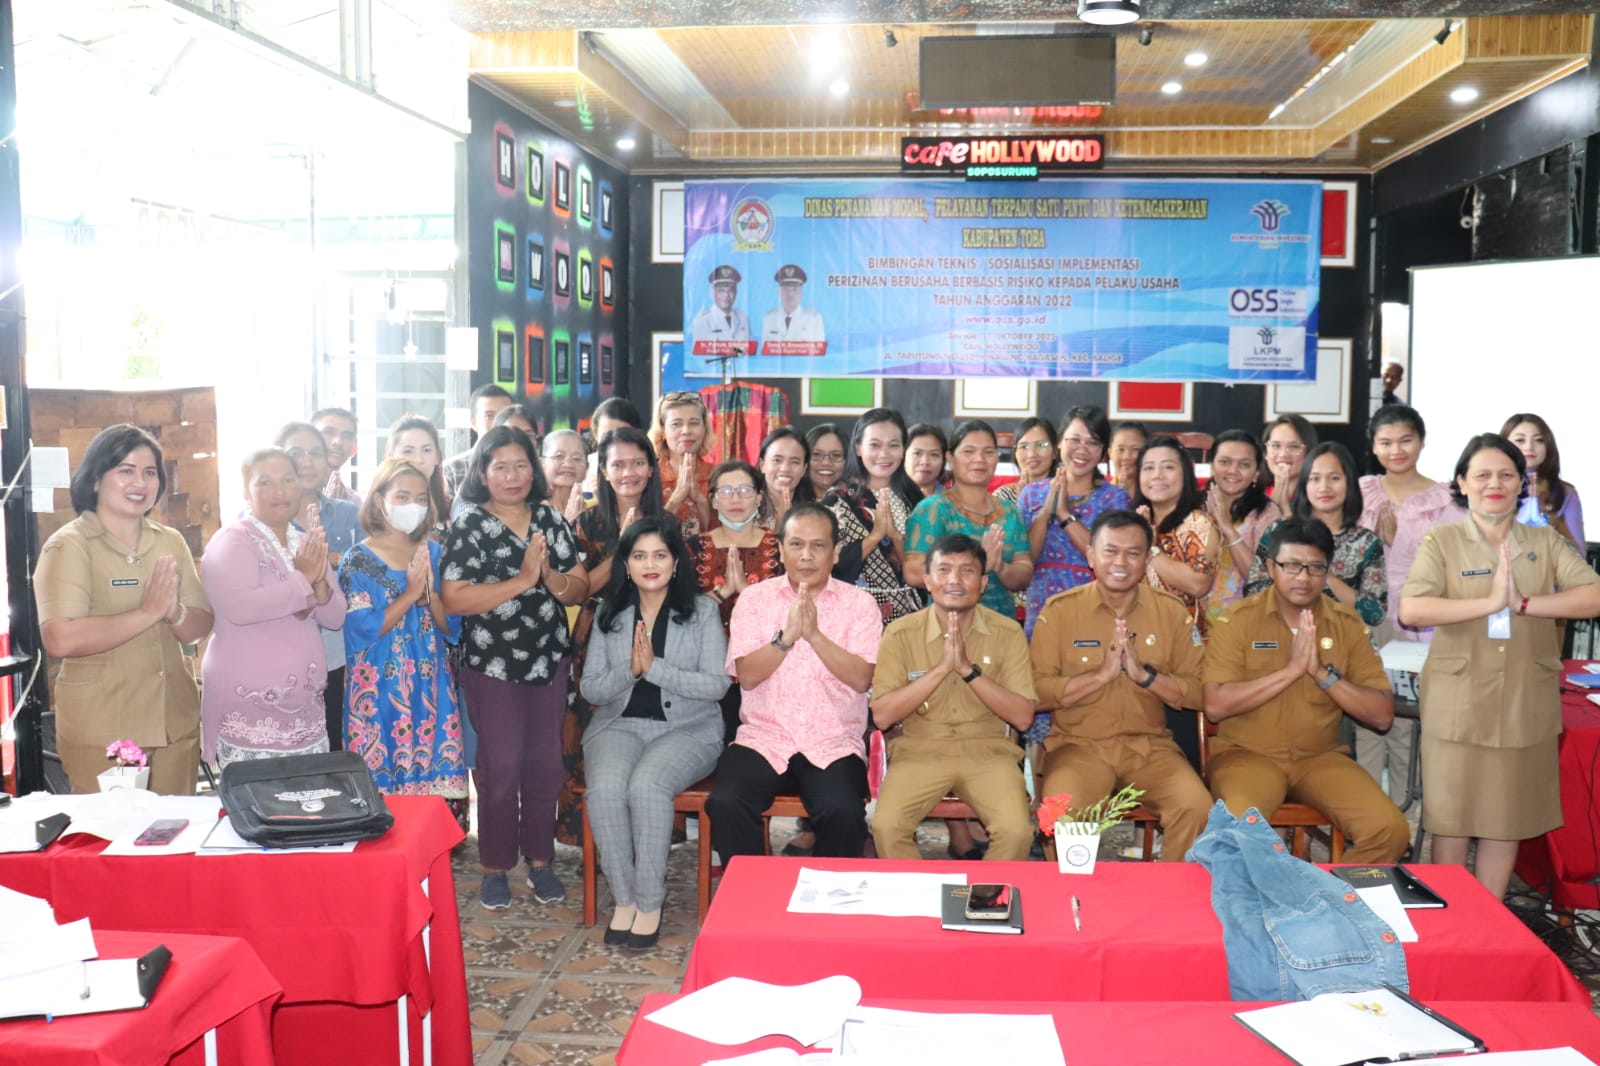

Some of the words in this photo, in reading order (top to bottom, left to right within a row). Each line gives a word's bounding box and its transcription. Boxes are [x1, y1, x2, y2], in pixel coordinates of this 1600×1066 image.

[971, 139, 1101, 164] HOLLYWOOD
[967, 167, 1037, 177] SOPOSURUNG
[805, 198, 833, 218] DINAS
[834, 198, 890, 218] PENANAMAN
[935, 198, 989, 218] PELAYANAN
[991, 198, 1034, 218] TERPADU
[1036, 198, 1060, 218] SATU
[1063, 198, 1089, 218] PINTU
[1092, 198, 1111, 218] DAN
[1113, 198, 1208, 219] KETENAGAKERJAAN
[962, 228, 1018, 248] KABUPATEN
[1019, 228, 1047, 248] TOBA
[868, 257, 934, 269] BIMBINGAN
[938, 257, 976, 269] TEKNIS
[988, 258, 1055, 270] SOSIALISASI
[1058, 258, 1139, 271] IMPLEMENTASI
[828, 275, 887, 287] PERIZINAN
[891, 276, 949, 287] BERUSAHA
[953, 276, 1003, 288] BERBASIS
[1007, 277, 1044, 288] RISIKO
[1048, 277, 1091, 288] KEPADA
[1096, 277, 1137, 289] PELAKU
[1142, 278, 1180, 289] USAHA
[933, 294, 972, 306] TAHUN
[976, 295, 1042, 306] ANGGARAN
[1045, 296, 1072, 307] 2022
[1231, 288, 1279, 312] OSS
[1254, 347, 1281, 356] LKPM
